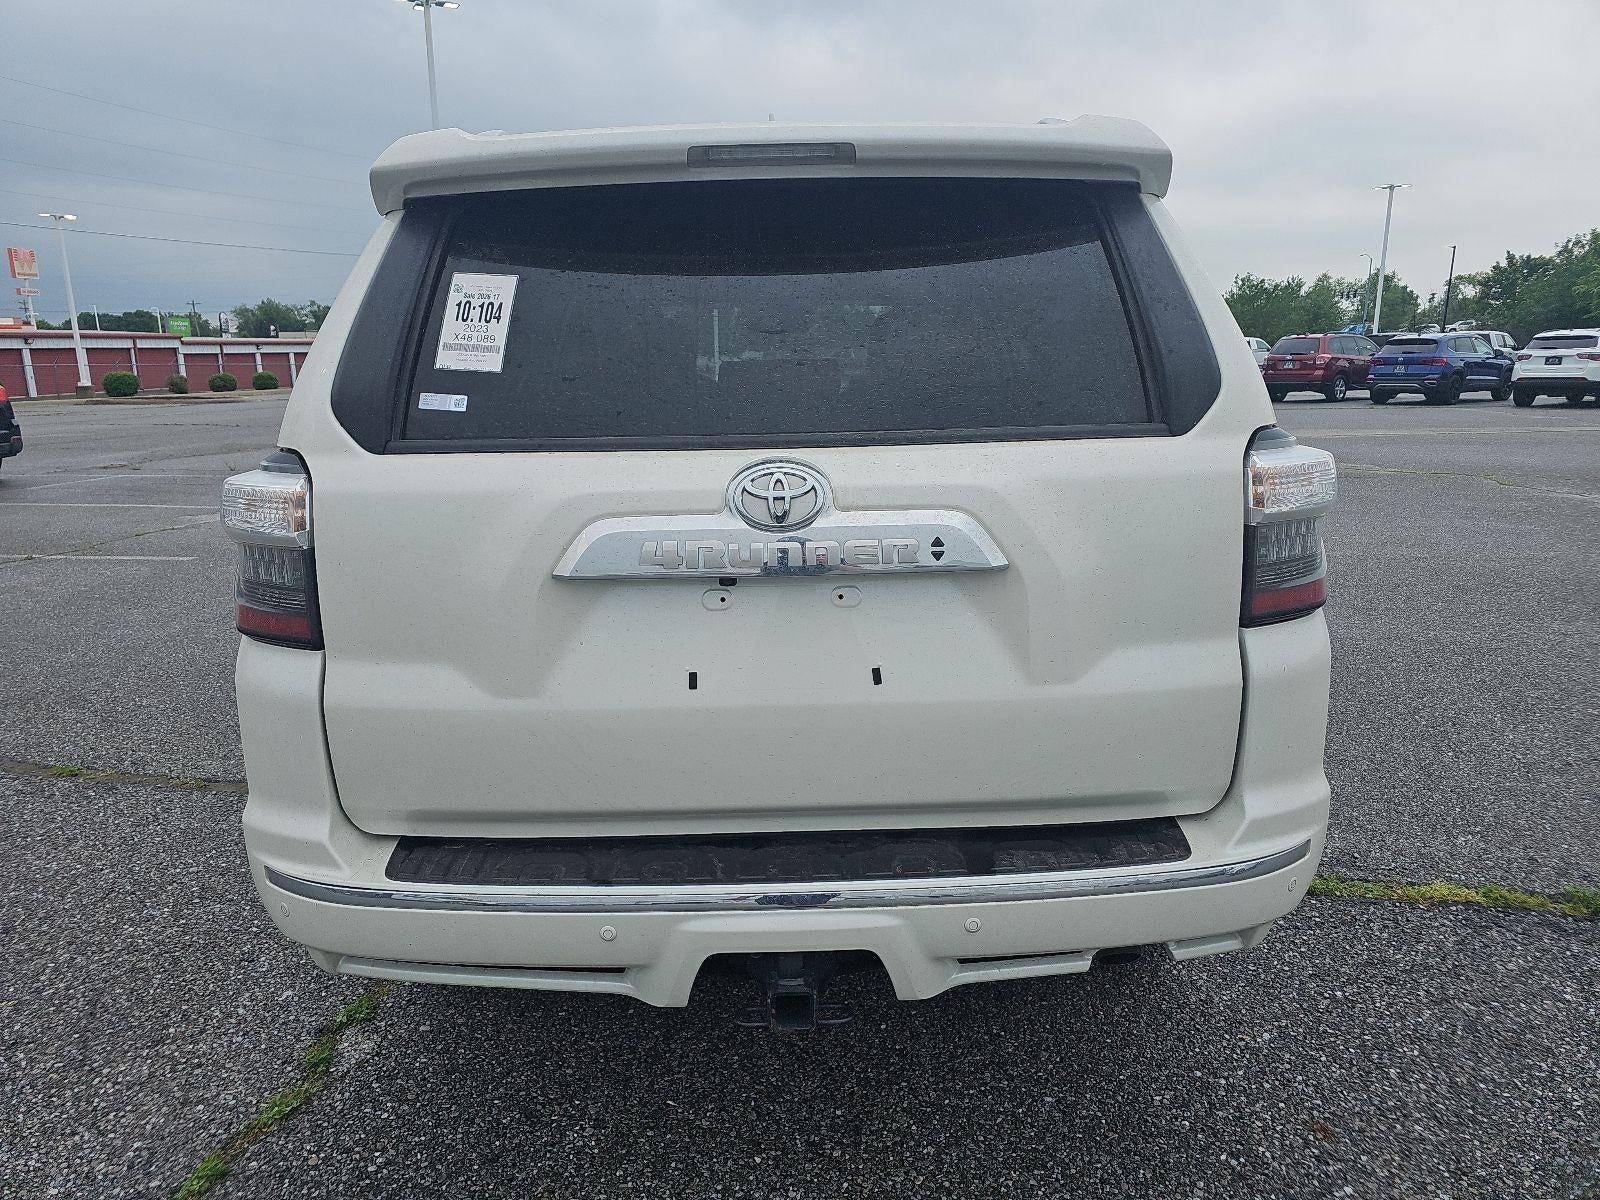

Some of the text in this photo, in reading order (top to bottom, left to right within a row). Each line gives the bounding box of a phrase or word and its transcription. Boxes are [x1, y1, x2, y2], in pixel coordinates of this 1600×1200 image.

[456, 300, 503, 324] 10:104
[463, 324, 489, 333] 2023
[639, 537, 920, 569] 4RUNNER
